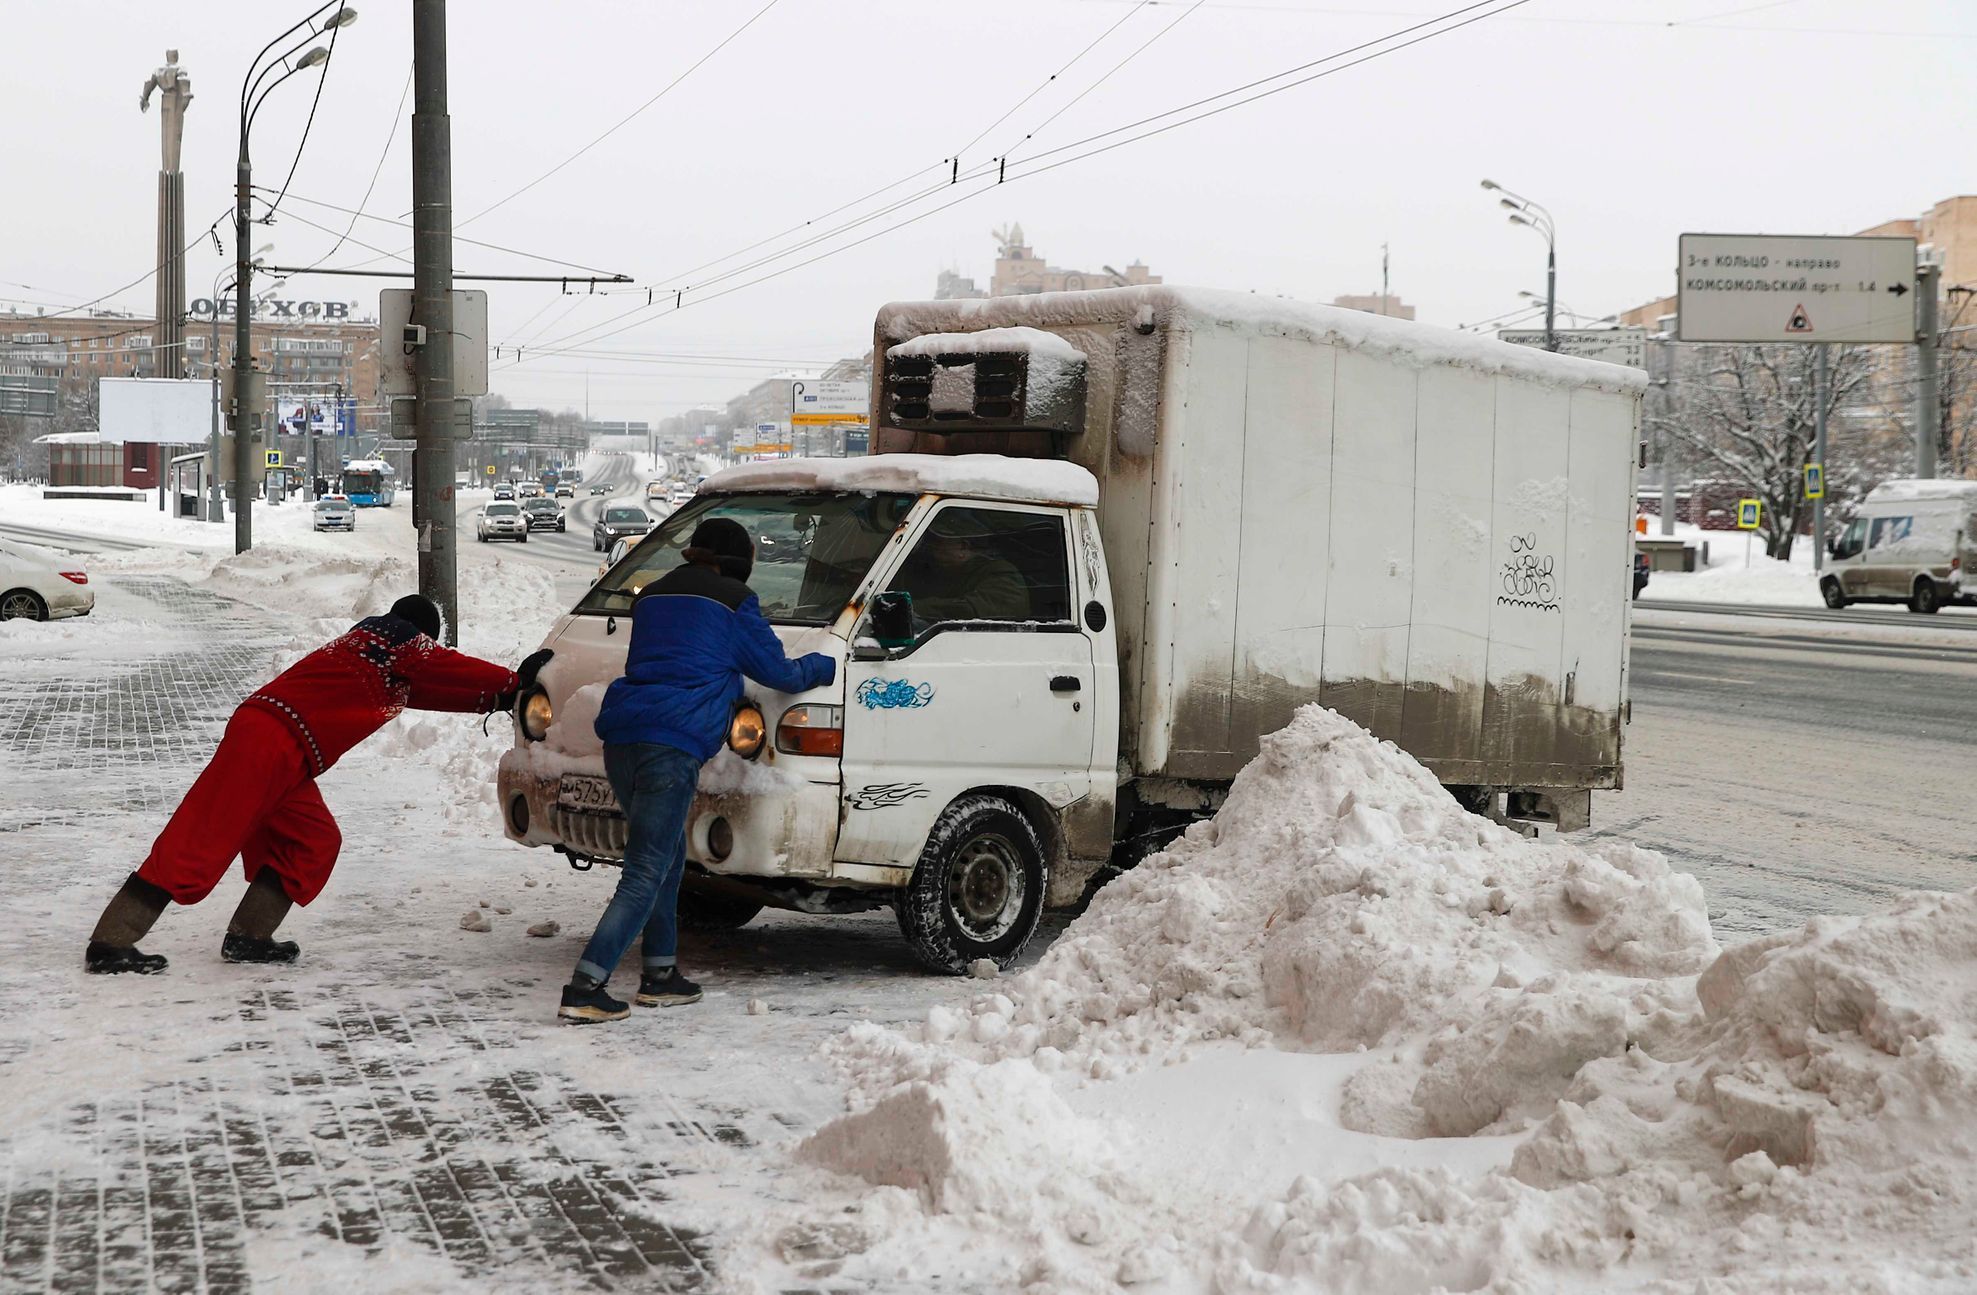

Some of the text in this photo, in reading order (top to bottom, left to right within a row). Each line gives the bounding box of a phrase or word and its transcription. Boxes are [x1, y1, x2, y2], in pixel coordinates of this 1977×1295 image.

[1687, 254, 1708, 267] 3-е
[1714, 254, 1769, 269] КОЛЬЦО
[1785, 257, 1841, 271] направо
[1686, 277, 1806, 292] КОМСОМОЛЬСКИЙ
